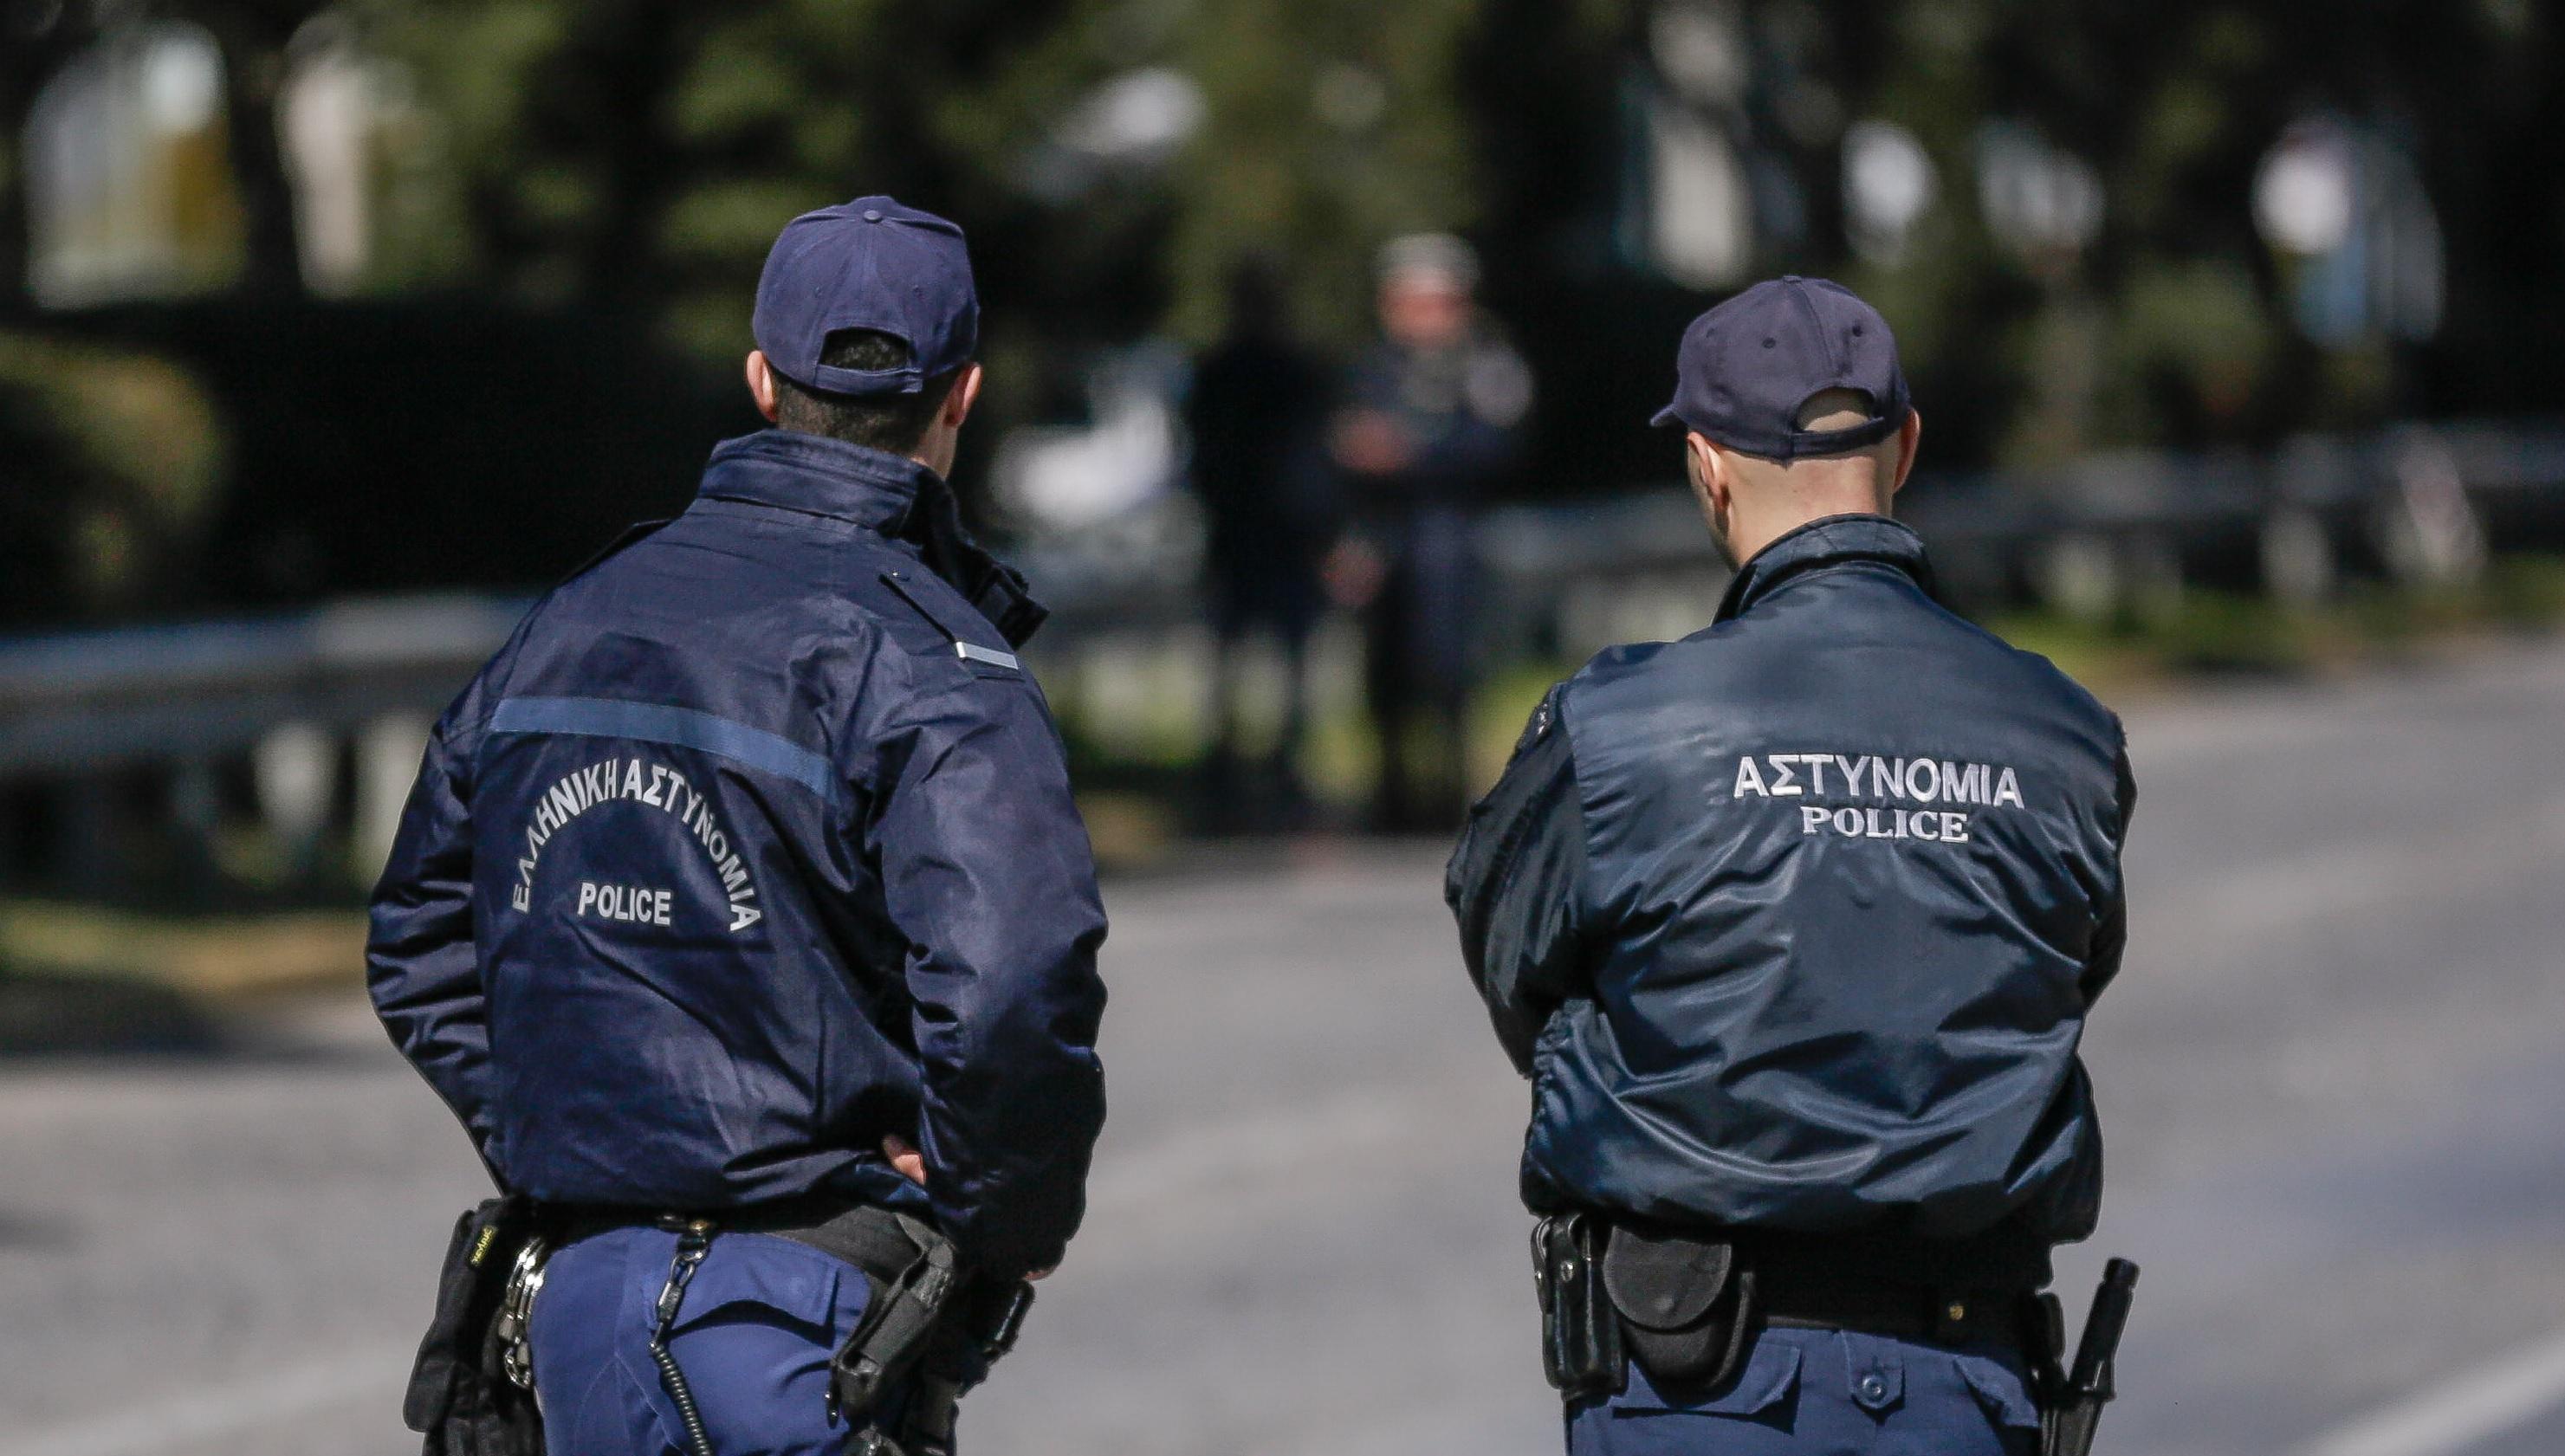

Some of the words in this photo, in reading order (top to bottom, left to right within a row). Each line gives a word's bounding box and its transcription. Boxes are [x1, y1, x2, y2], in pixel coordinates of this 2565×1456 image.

[1733, 754, 2024, 809] ΑΣΤΥΝΟΜΙΑ
[512, 759, 618, 914] ΕΛΛΗΝΙΚΗ
[620, 759, 761, 931] ΑΣΤΥΝΟΜΙΑ
[1800, 806, 1968, 844] POLICE
[578, 882, 671, 925] POLICE
